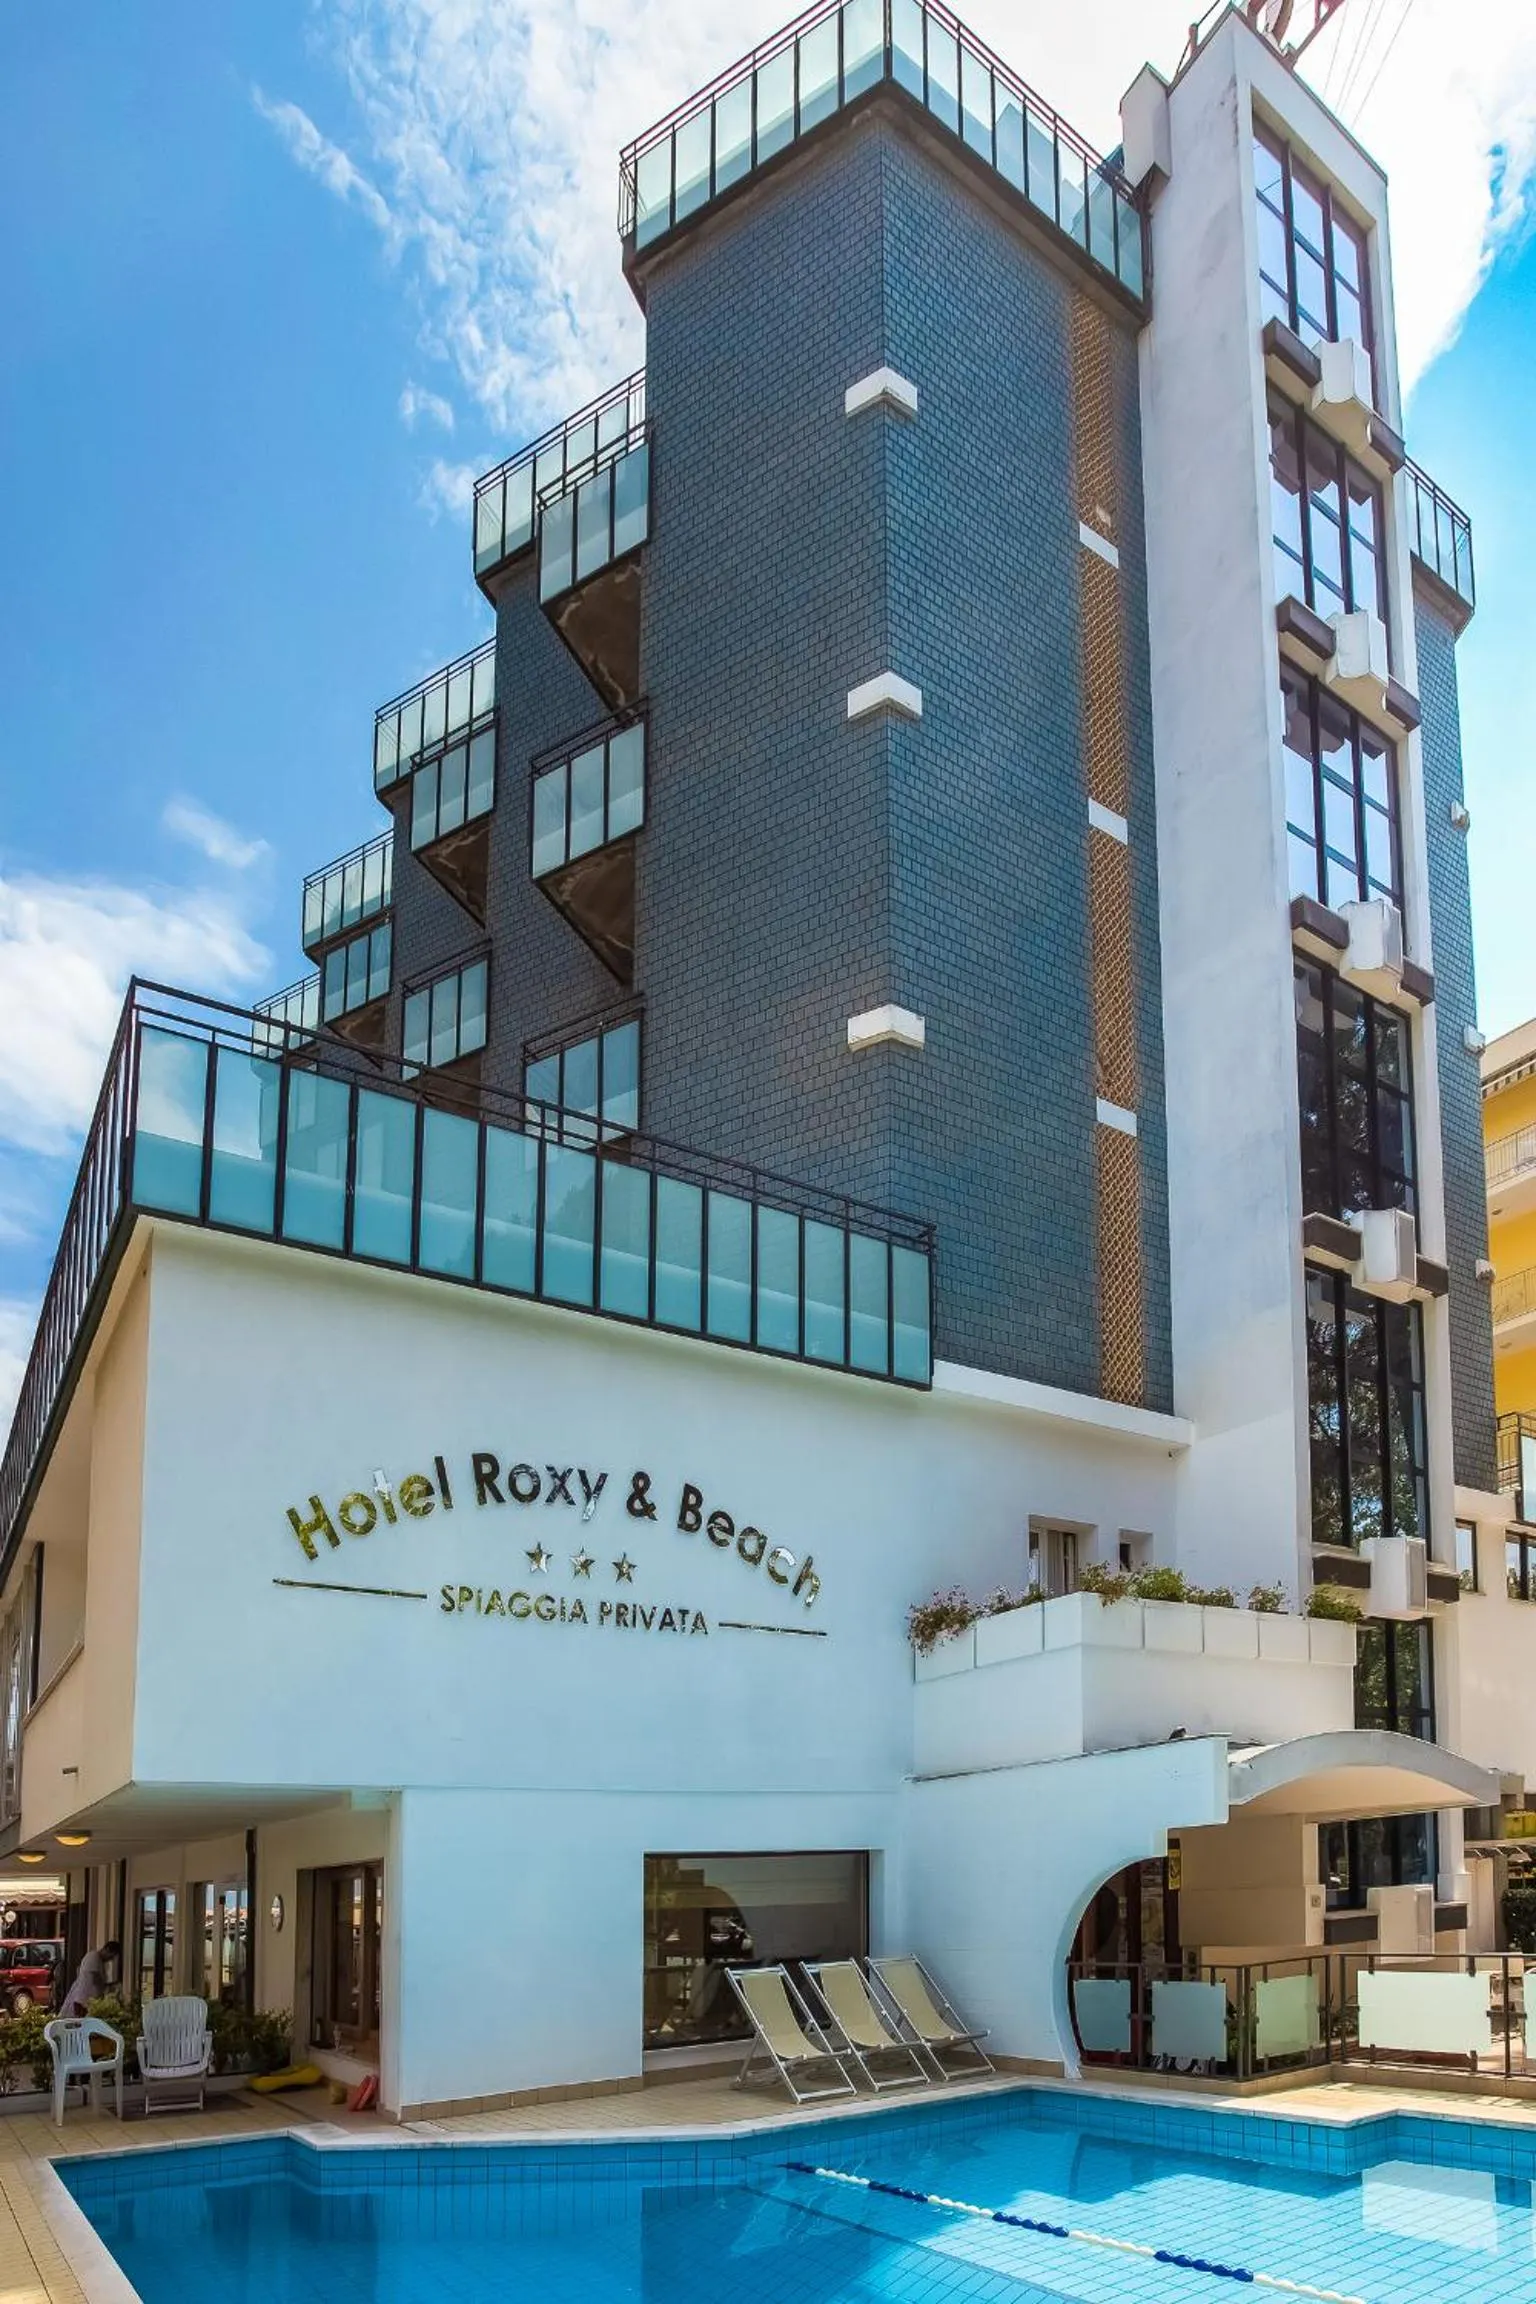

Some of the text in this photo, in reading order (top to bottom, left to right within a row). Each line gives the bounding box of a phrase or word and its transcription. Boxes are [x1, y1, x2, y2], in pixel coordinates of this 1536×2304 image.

[286, 1453, 820, 1608] Hotel Roxy & Beach
[440, 1584, 709, 1636] SPIAGGIA PRIVATA
